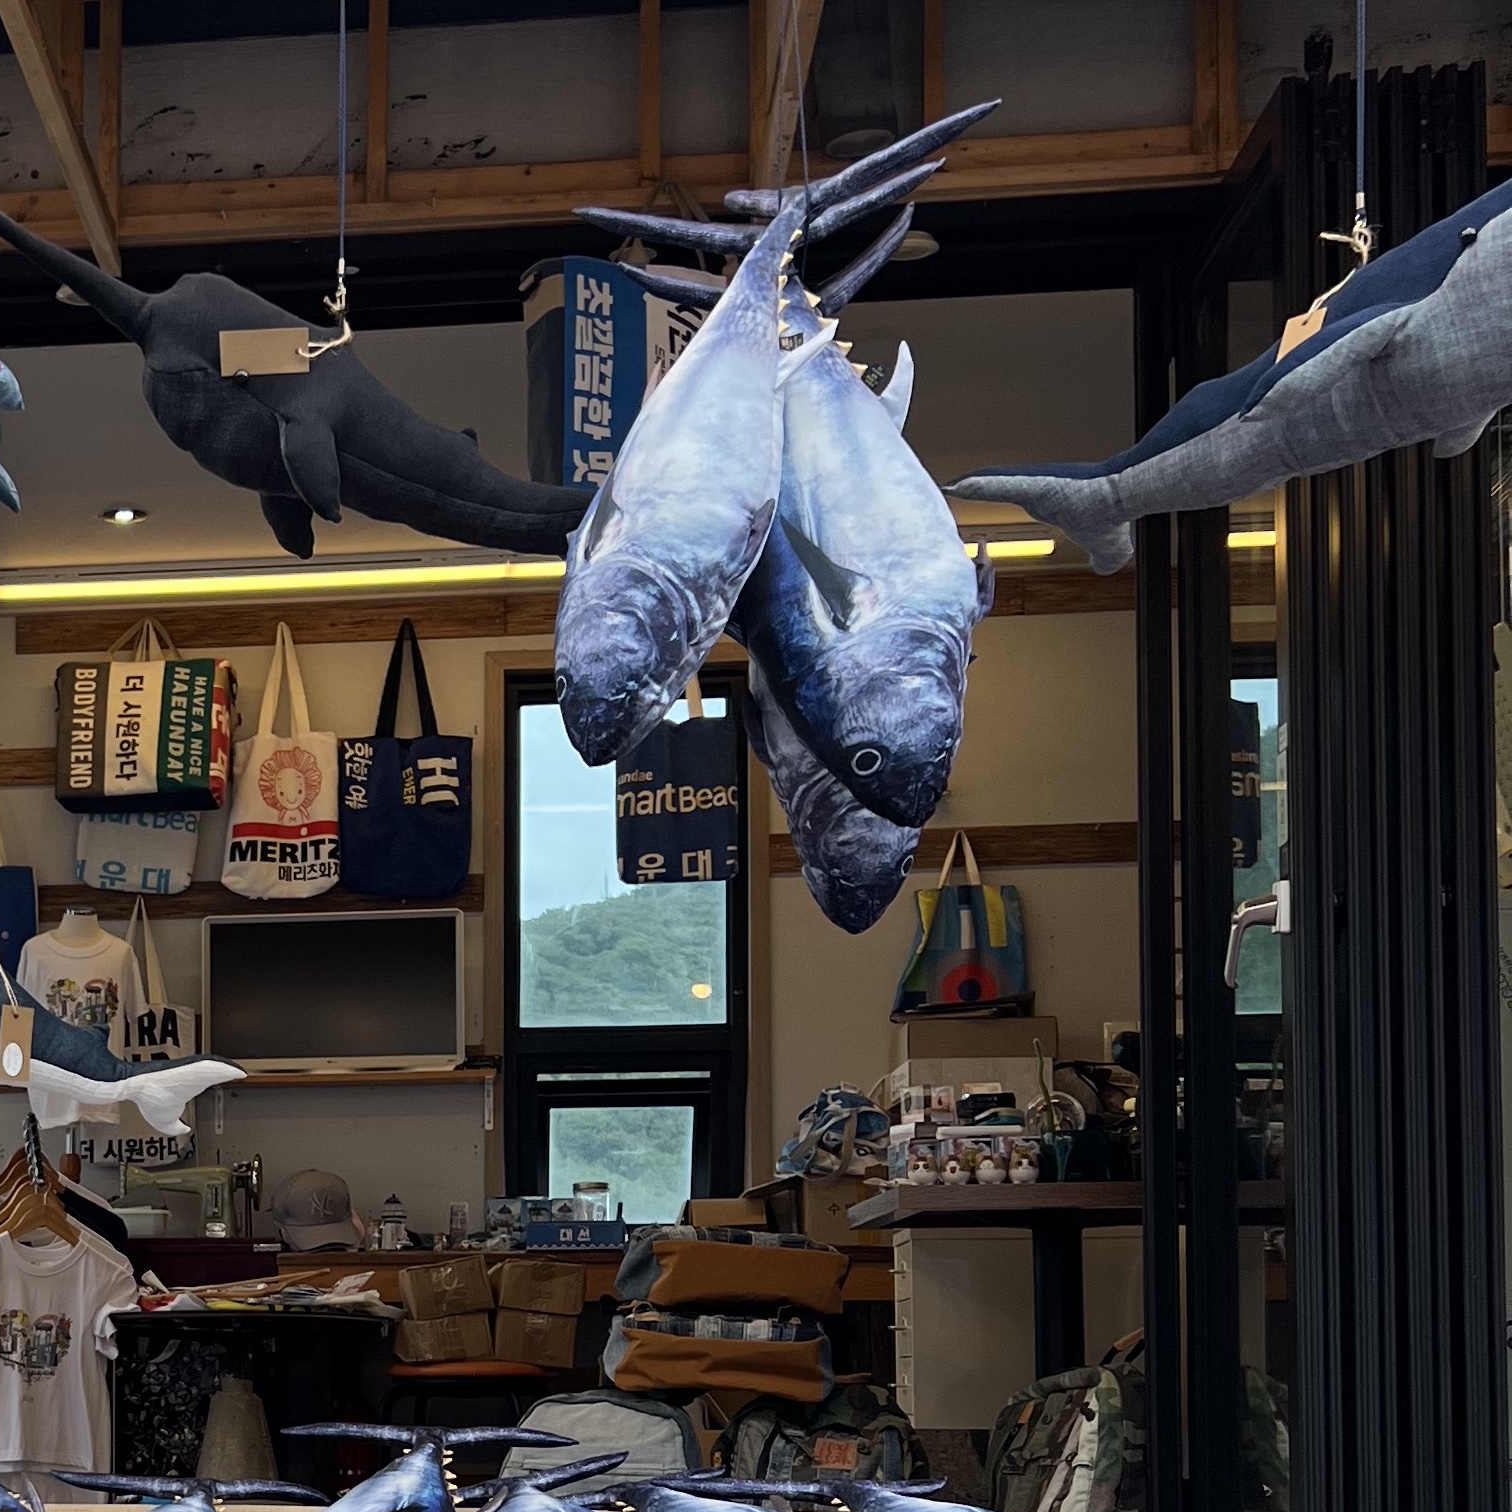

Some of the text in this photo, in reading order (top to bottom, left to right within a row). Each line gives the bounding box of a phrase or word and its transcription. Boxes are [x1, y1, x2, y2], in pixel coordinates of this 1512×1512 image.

[573, 273, 614, 441] 초깔끔한
[69, 668, 98, 789] BODYFRIEND
[114, 675, 145, 781] 더 시원하다
[167, 666, 191, 783] HAEUNDAY
[189, 676, 208, 777] HAVE A NICE
[124, 1007, 181, 1048] RA
